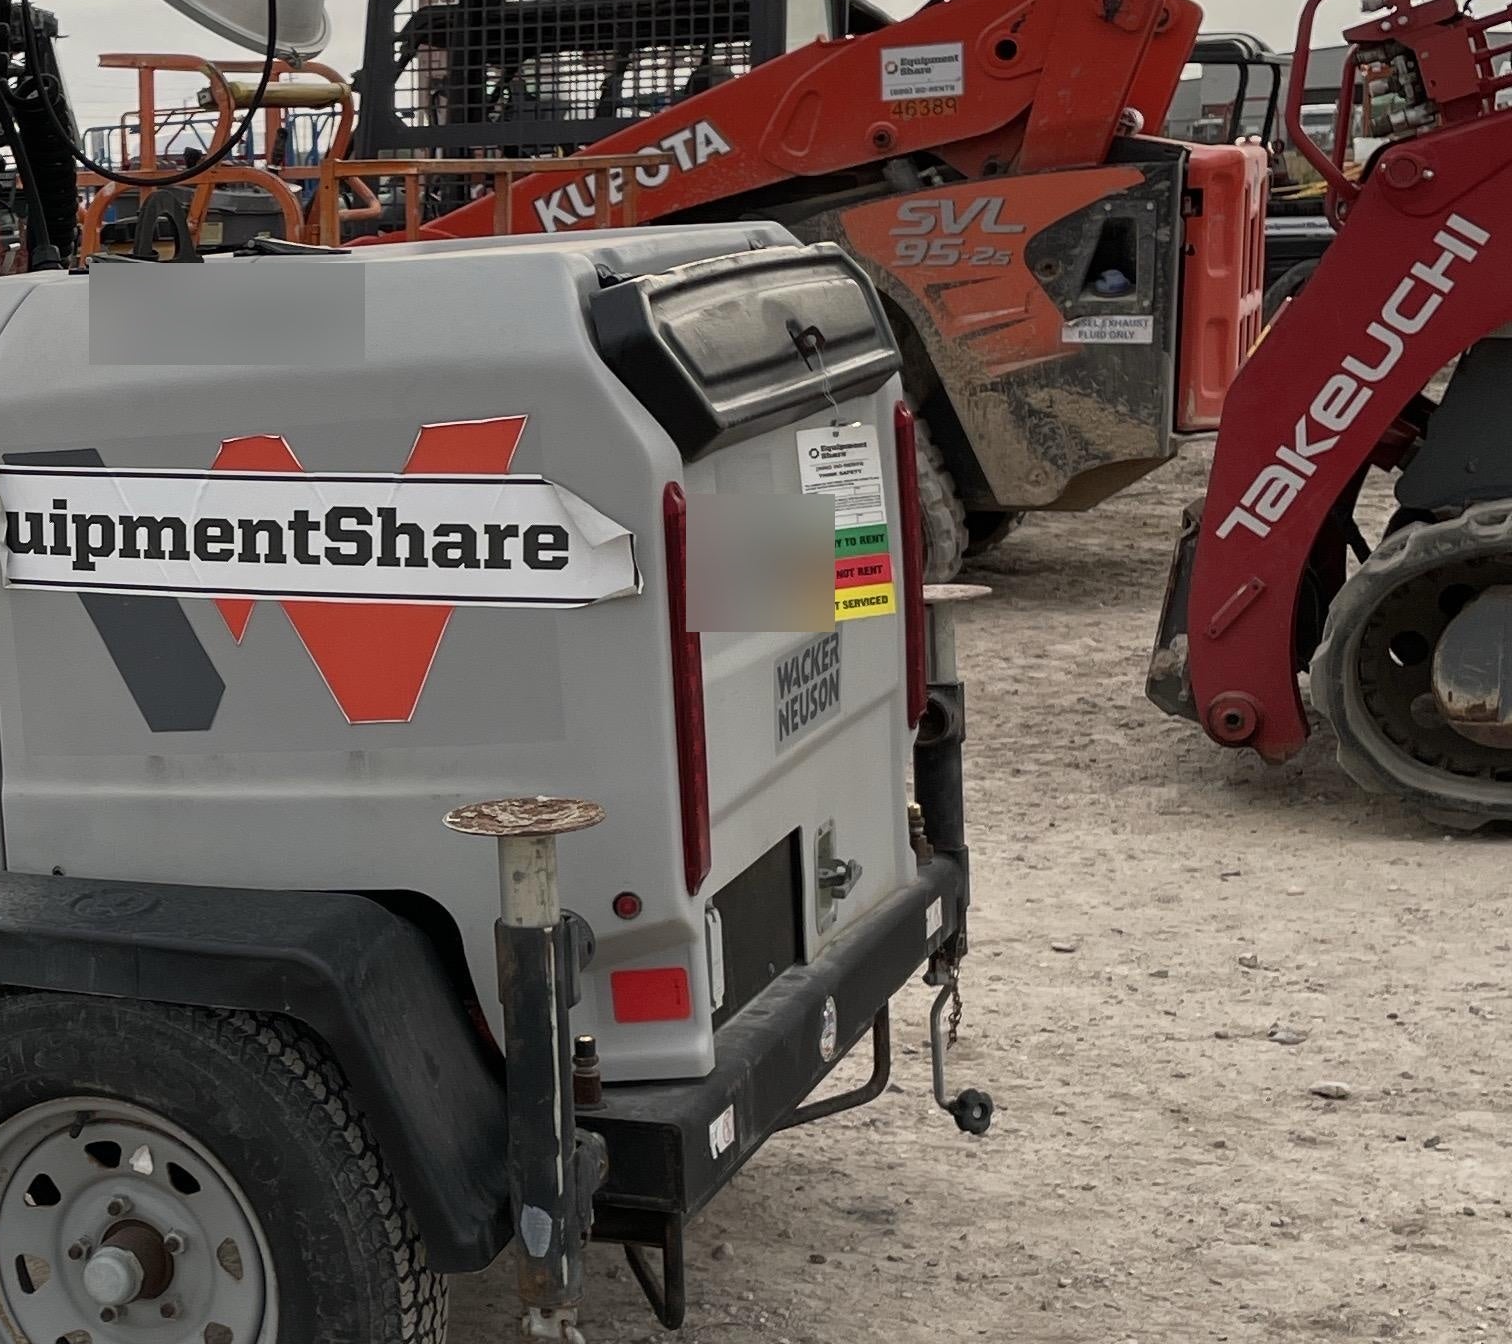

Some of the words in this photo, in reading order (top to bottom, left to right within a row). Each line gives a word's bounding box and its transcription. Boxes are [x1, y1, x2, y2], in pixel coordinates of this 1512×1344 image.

[900, 55, 959, 67] Equipment
[900, 67, 932, 76] Share
[891, 97, 957, 118] 46389
[889, 197, 1027, 236] SVL
[845, 537, 856, 546] TO
[859, 534, 885, 544] RENT
[836, 568, 855, 579] NOT
[857, 565, 884, 576] RENT
[842, 595, 889, 609] SERVICED
[777, 632, 840, 699] WACKER
[778, 668, 840, 742] NEUSON
